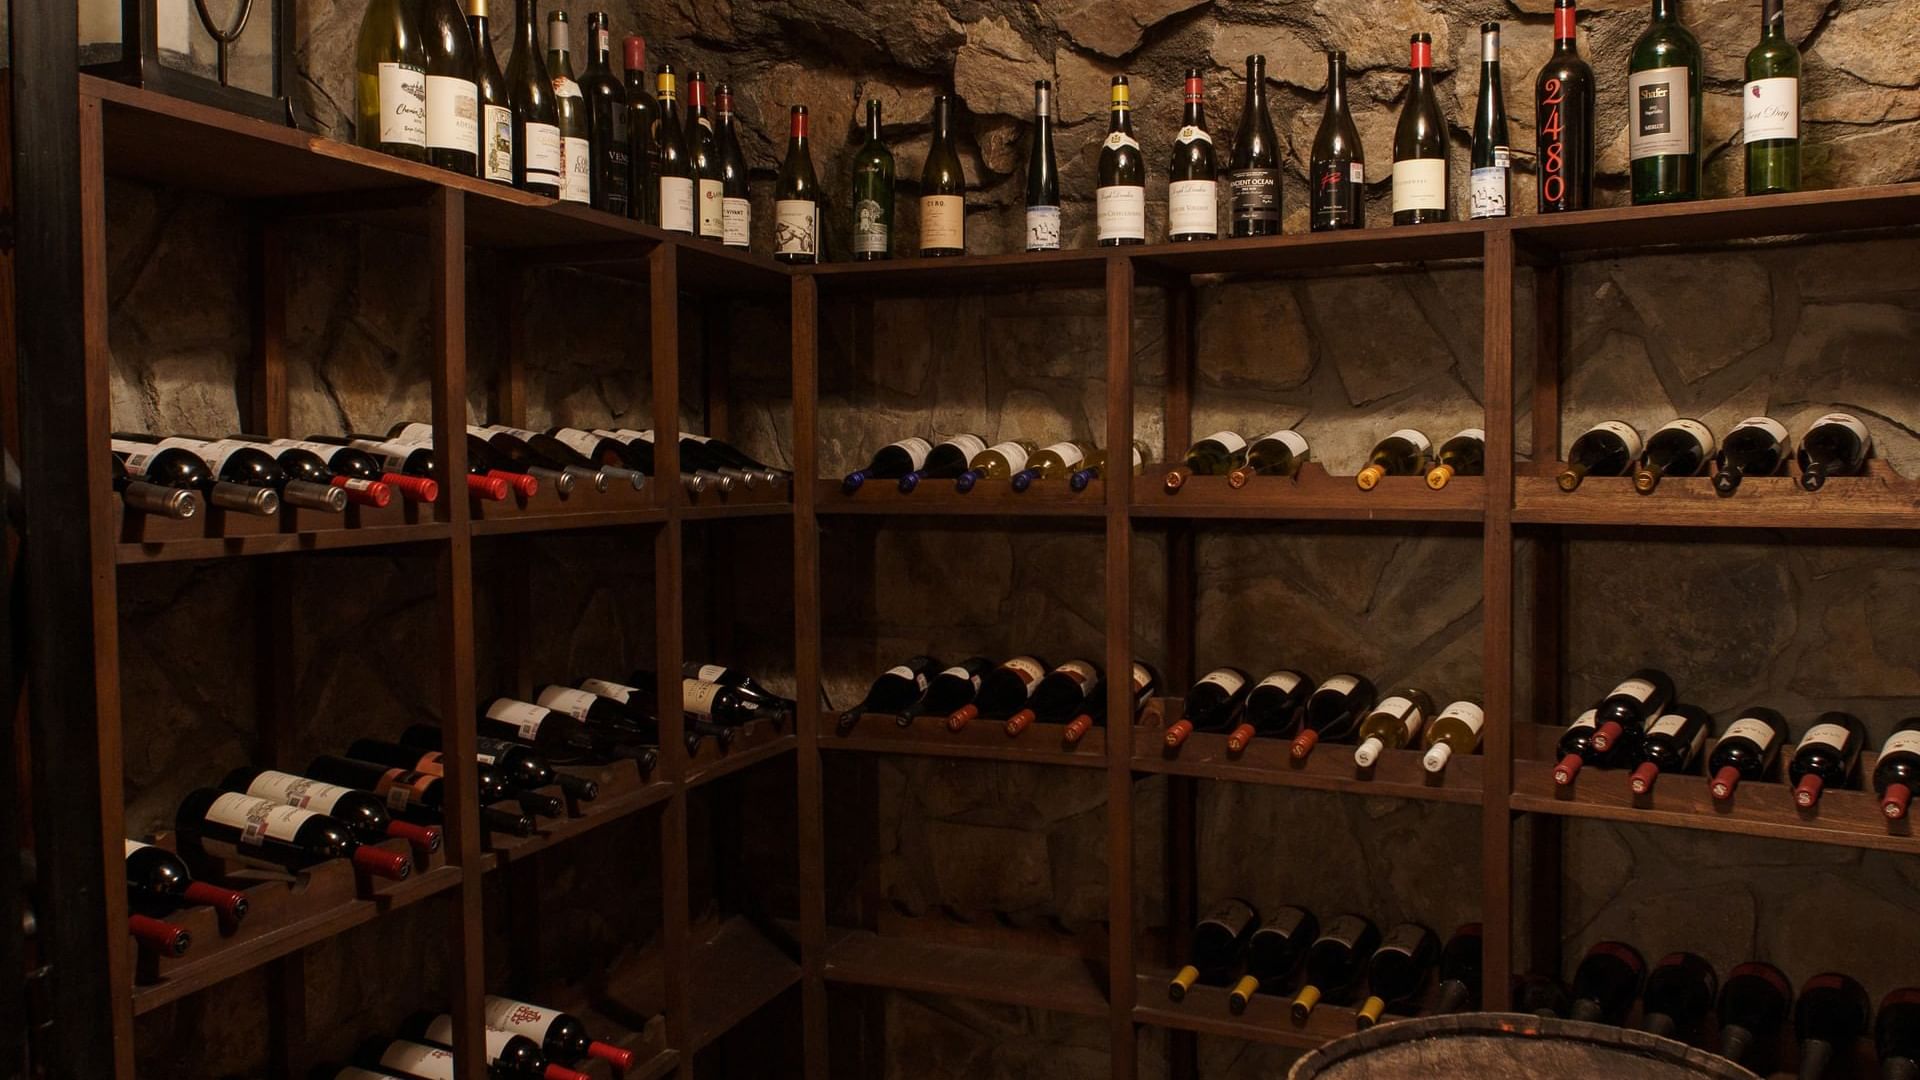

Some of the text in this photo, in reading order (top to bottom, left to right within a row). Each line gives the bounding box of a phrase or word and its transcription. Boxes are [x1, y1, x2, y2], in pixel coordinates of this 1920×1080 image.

[1640, 87, 1668, 99] Shafer
[1541, 77, 1564, 202] 2480
[1251, 178, 1274, 186] OCEAN
